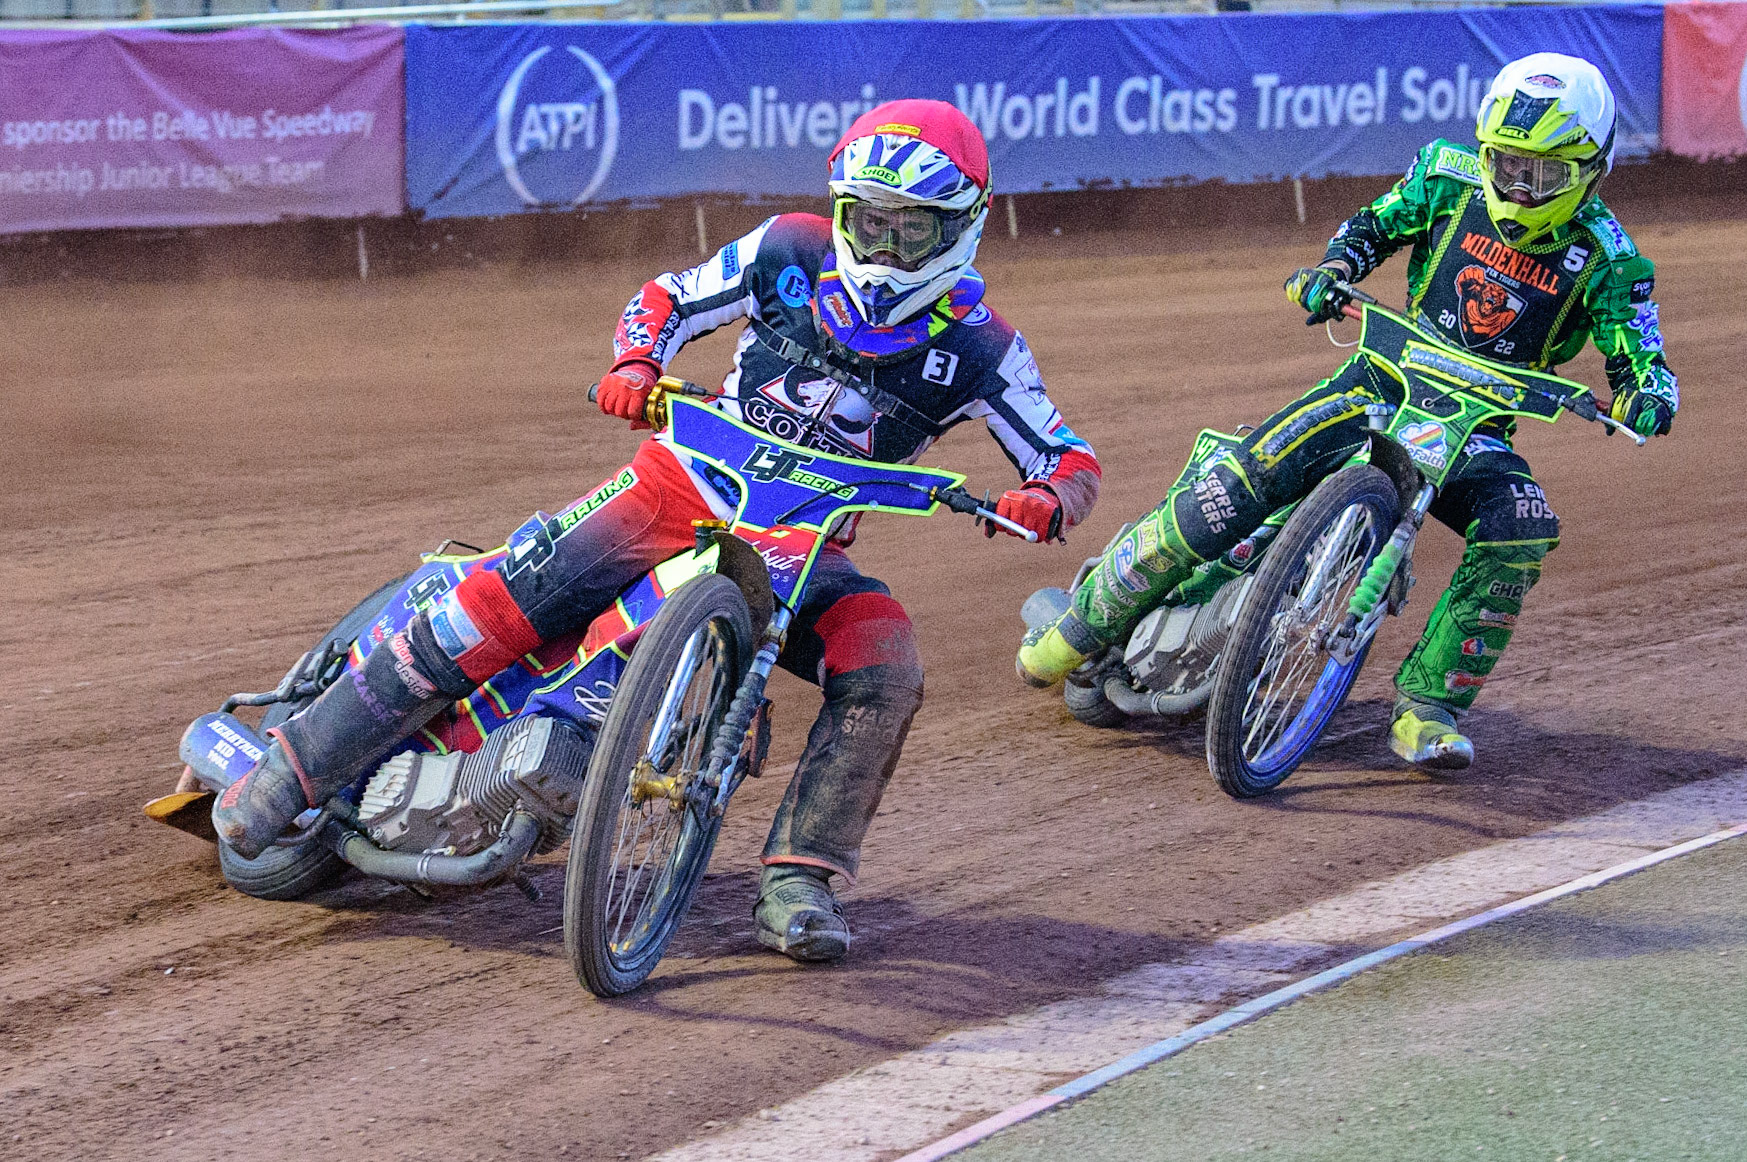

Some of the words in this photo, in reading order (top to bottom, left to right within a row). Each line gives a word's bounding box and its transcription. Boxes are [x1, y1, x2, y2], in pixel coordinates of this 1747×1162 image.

[956, 75, 1098, 141] World
[1114, 86, 1237, 135] Class
[1253, 65, 1387, 131] Travel
[3, 116, 101, 150] sponsor
[106, 110, 146, 142] the
[152, 109, 210, 141] Belle
[212, 111, 256, 140] Vue
[263, 104, 375, 144] Speedway
[518, 101, 596, 153] ATPI
[1496, 126, 1530, 139] BELL
[102, 160, 173, 191] Junior
[179, 160, 262, 195] League
[265, 157, 326, 187] Team
[861, 166, 897, 183] SHOEI
[1460, 232, 1560, 296] MILDENHALL
[1562, 244, 1589, 273] 5
[1438, 309, 1457, 330] 20
[1494, 339, 1516, 356] 22
[928, 351, 952, 383] 3
[560, 469, 635, 532] RACING
[788, 470, 855, 498] RACING
[1202, 471, 1238, 520] TERRY
[395, 660, 430, 700] design
